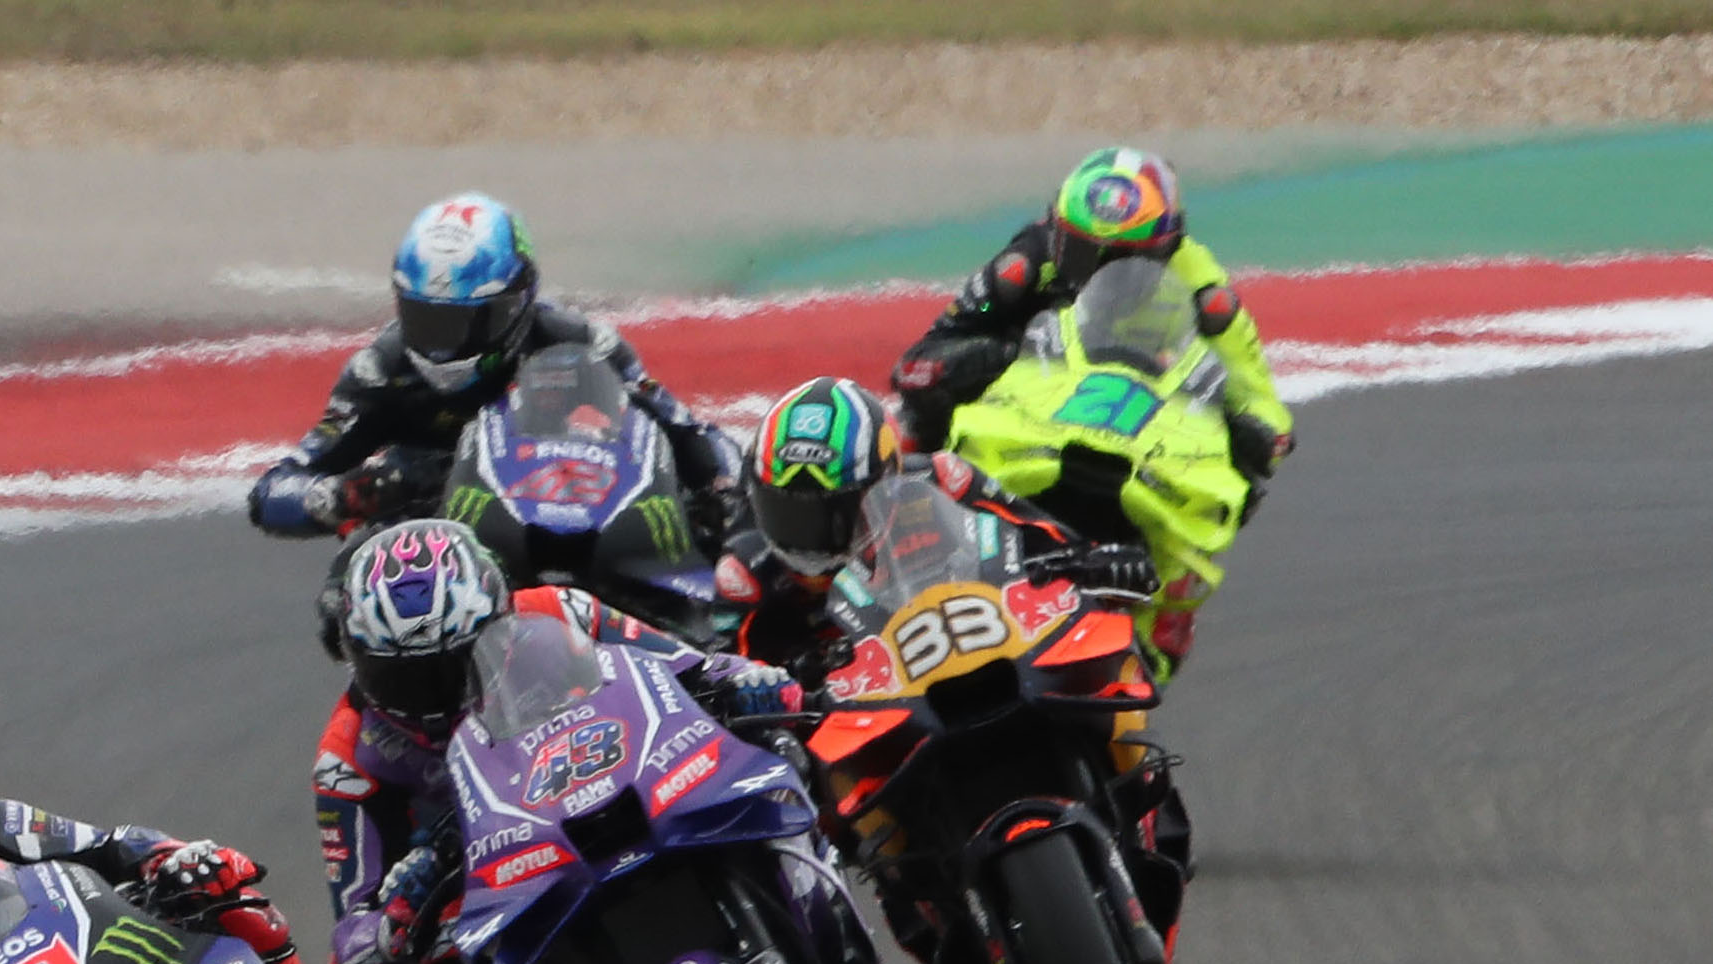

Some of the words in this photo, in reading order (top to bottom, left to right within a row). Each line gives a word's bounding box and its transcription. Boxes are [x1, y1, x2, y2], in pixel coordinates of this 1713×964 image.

[1052, 372, 1165, 437] 21
[894, 595, 1009, 681] 33
[518, 704, 596, 756] prima
[646, 719, 715, 773] prima
[524, 719, 627, 807] 43
[655, 753, 717, 805] MOTUL
[563, 775, 617, 814] FIAMM
[466, 821, 534, 871] prima
[495, 845, 560, 885] MOTUL
